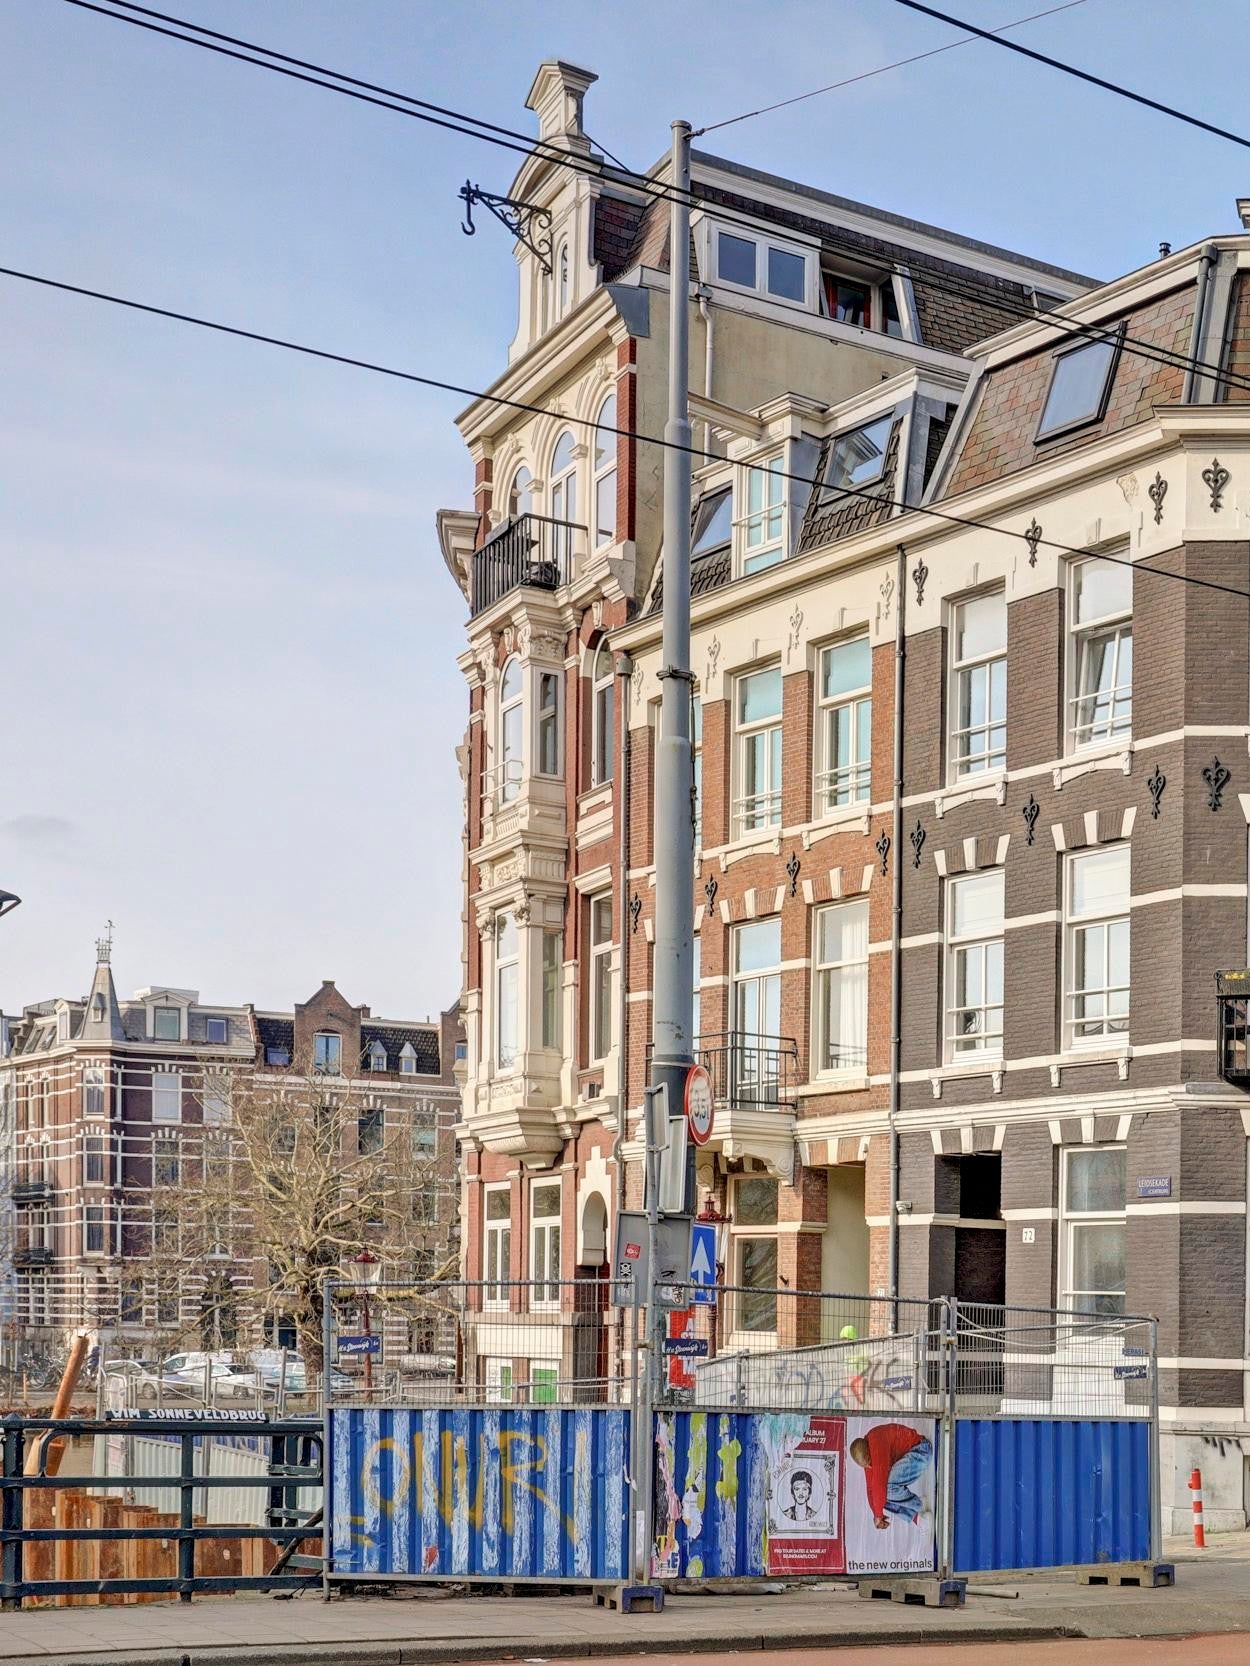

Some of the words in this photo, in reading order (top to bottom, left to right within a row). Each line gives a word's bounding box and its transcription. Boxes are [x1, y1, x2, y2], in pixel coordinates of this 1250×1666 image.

[1024, 1230, 1034, 1241] 72
[111, 1408, 141, 1419] WIM
[150, 1408, 266, 1421] SONNEVELDBRUG
[848, 1560, 865, 1570] the
[866, 1561, 888, 1570] new
[889, 1558, 933, 1571] originals
